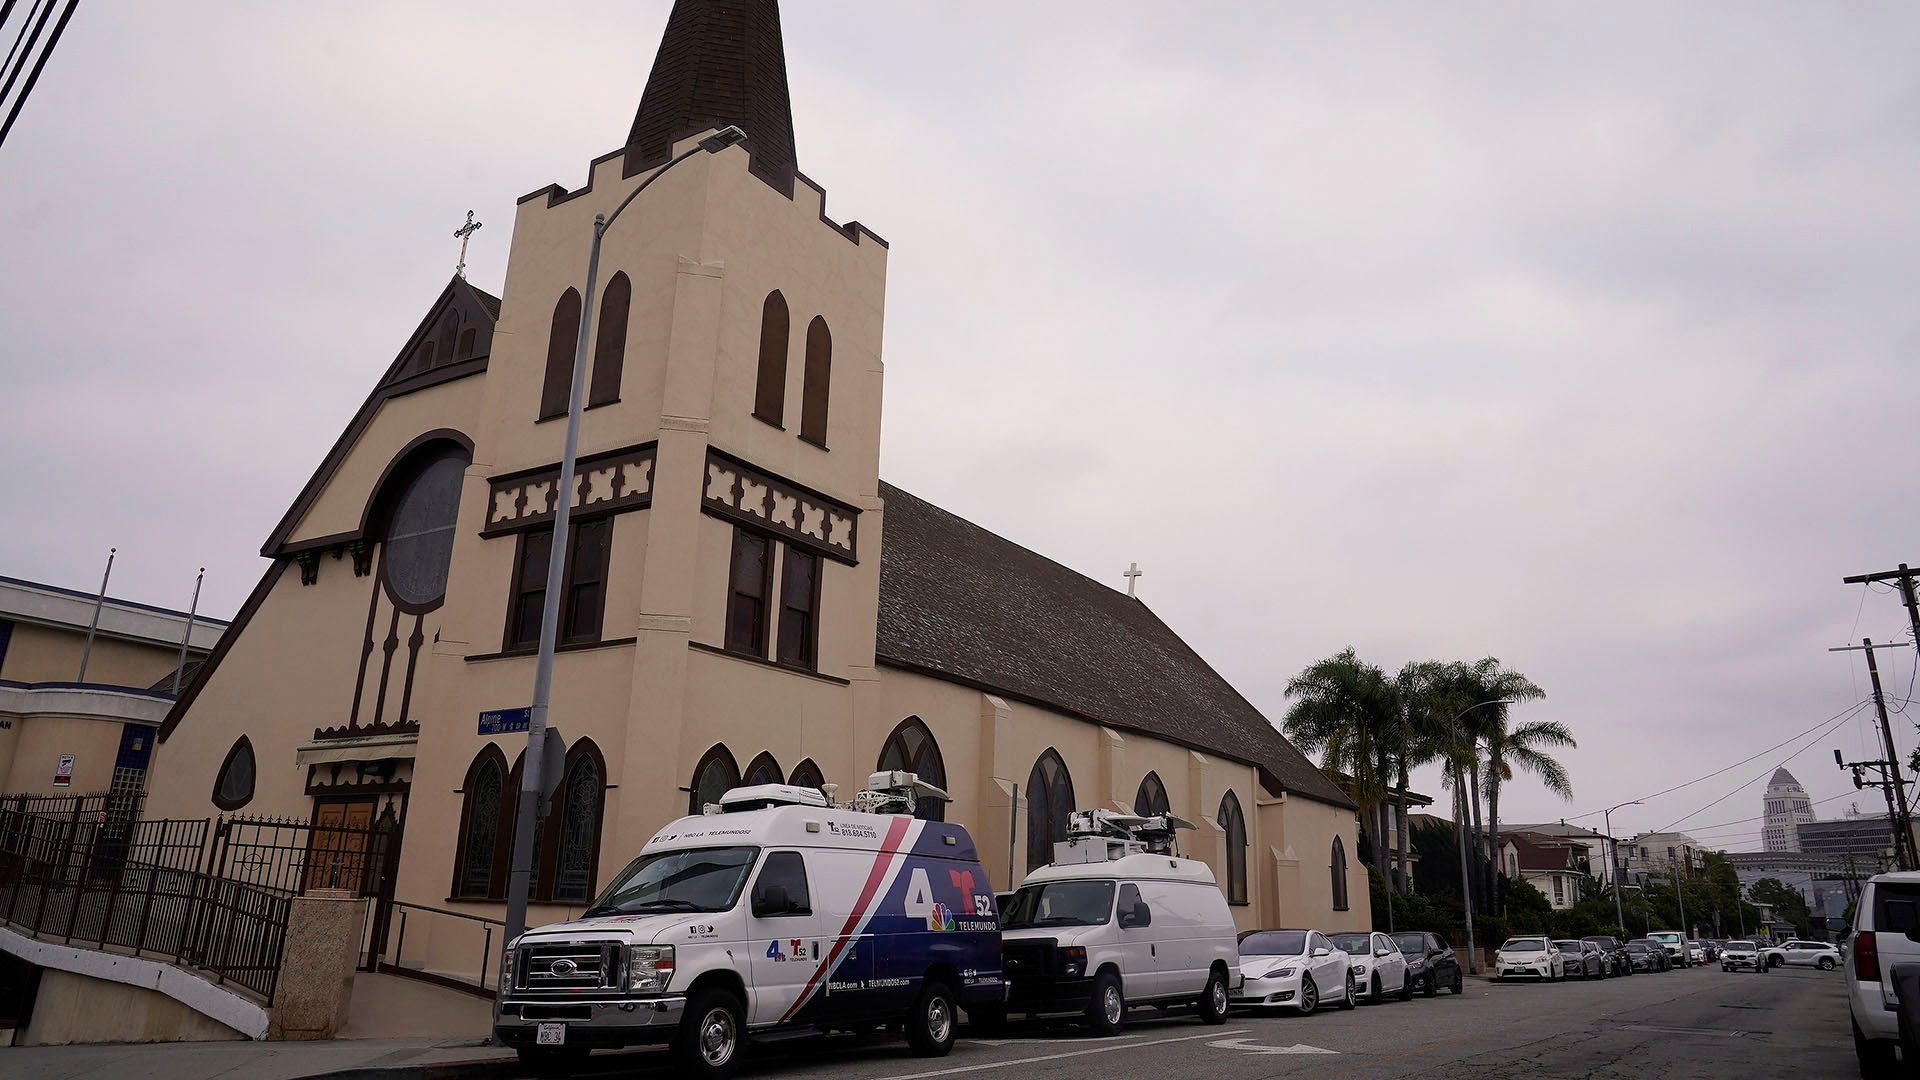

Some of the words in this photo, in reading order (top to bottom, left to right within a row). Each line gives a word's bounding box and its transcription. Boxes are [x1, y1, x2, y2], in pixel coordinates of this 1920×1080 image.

[480, 712, 501, 727] Alpine
[904, 868, 935, 931] 4
[974, 895, 993, 916] 52
[959, 921, 997, 931] TELEMUNDO
[766, 940, 779, 962] 4
[799, 948, 807, 956] 52
